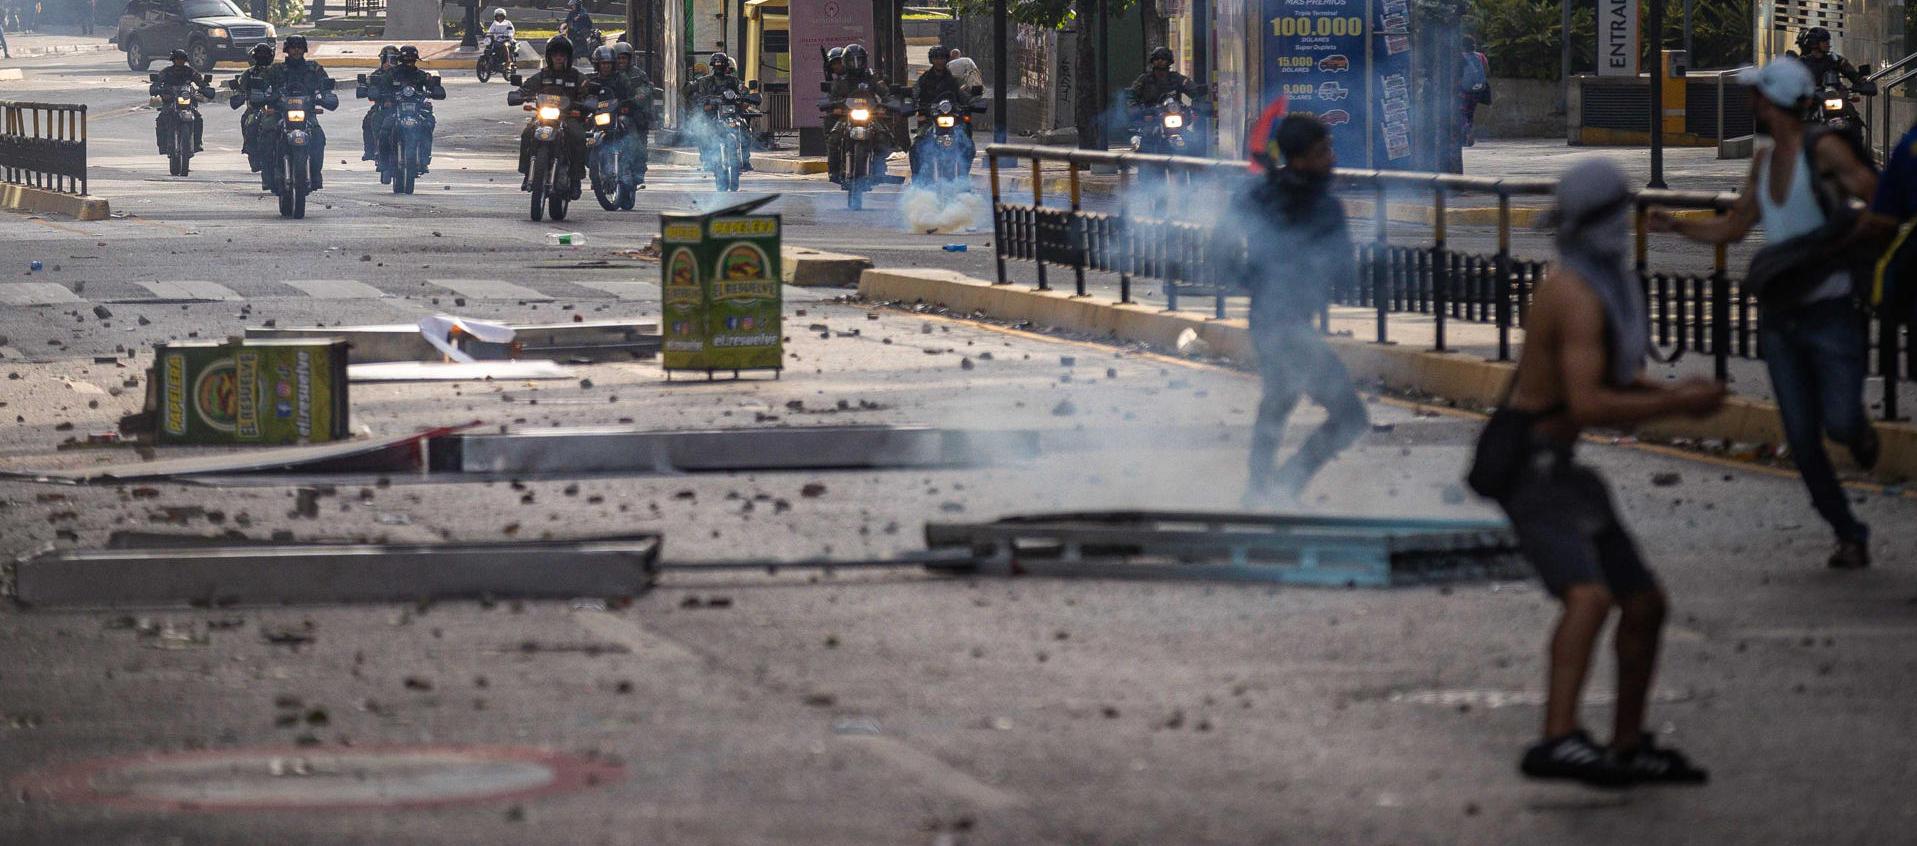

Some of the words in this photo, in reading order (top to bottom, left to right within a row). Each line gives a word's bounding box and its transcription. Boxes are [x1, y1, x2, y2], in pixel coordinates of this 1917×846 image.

[1270, 17, 1361, 36] 100.000
[1278, 56, 1313, 67] 15.000
[1283, 84, 1313, 94] 9.000
[714, 219, 775, 233] PAPELERA
[168, 357, 182, 430] PAPELERA
[241, 353, 255, 419] RESUELVE
